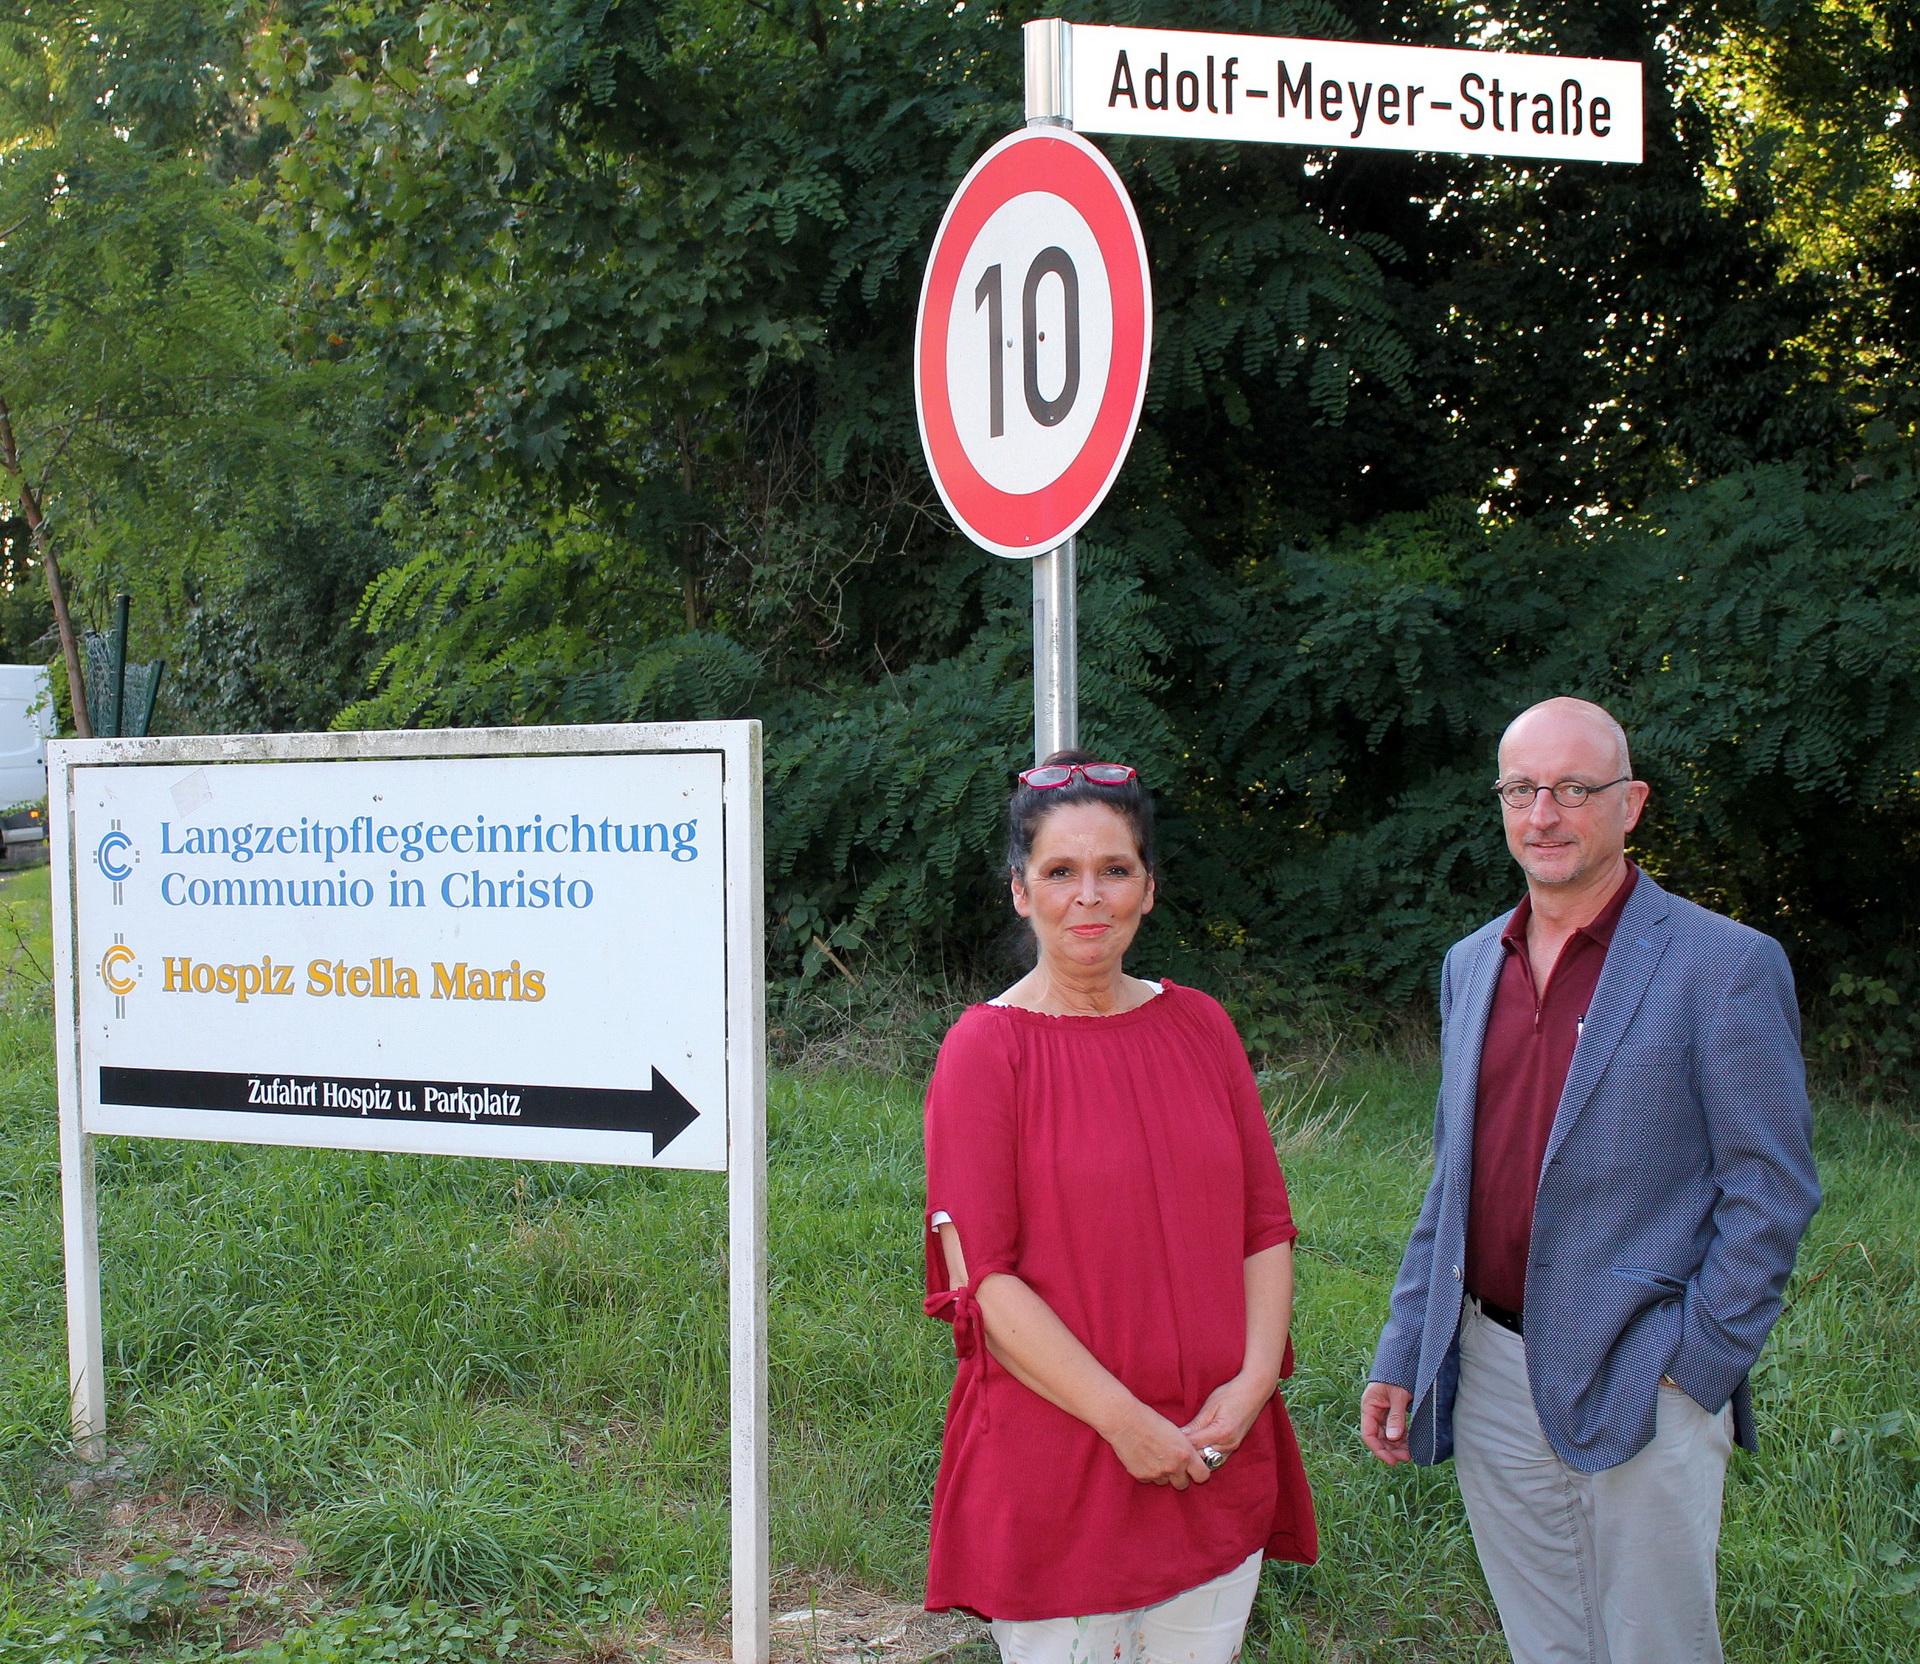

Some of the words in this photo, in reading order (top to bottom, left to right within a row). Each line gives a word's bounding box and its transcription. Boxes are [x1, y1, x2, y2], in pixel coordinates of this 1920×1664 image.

[1108, 49, 1612, 139] Adolf-Meyer-Straße
[975, 246, 1081, 438] 10
[160, 813, 699, 863] Langzeitpflegeeinrichtung
[160, 869, 374, 907] Communio
[388, 869, 426, 907] in
[440, 869, 594, 910] Christo
[161, 954, 296, 1004] Hospiz
[305, 956, 421, 999] Stella
[430, 959, 546, 1003] Maris
[247, 1078, 318, 1107] Zufahrt
[322, 1082, 393, 1116] Hospiz
[397, 1090, 417, 1112] u.
[423, 1085, 522, 1121] Parkplatz
